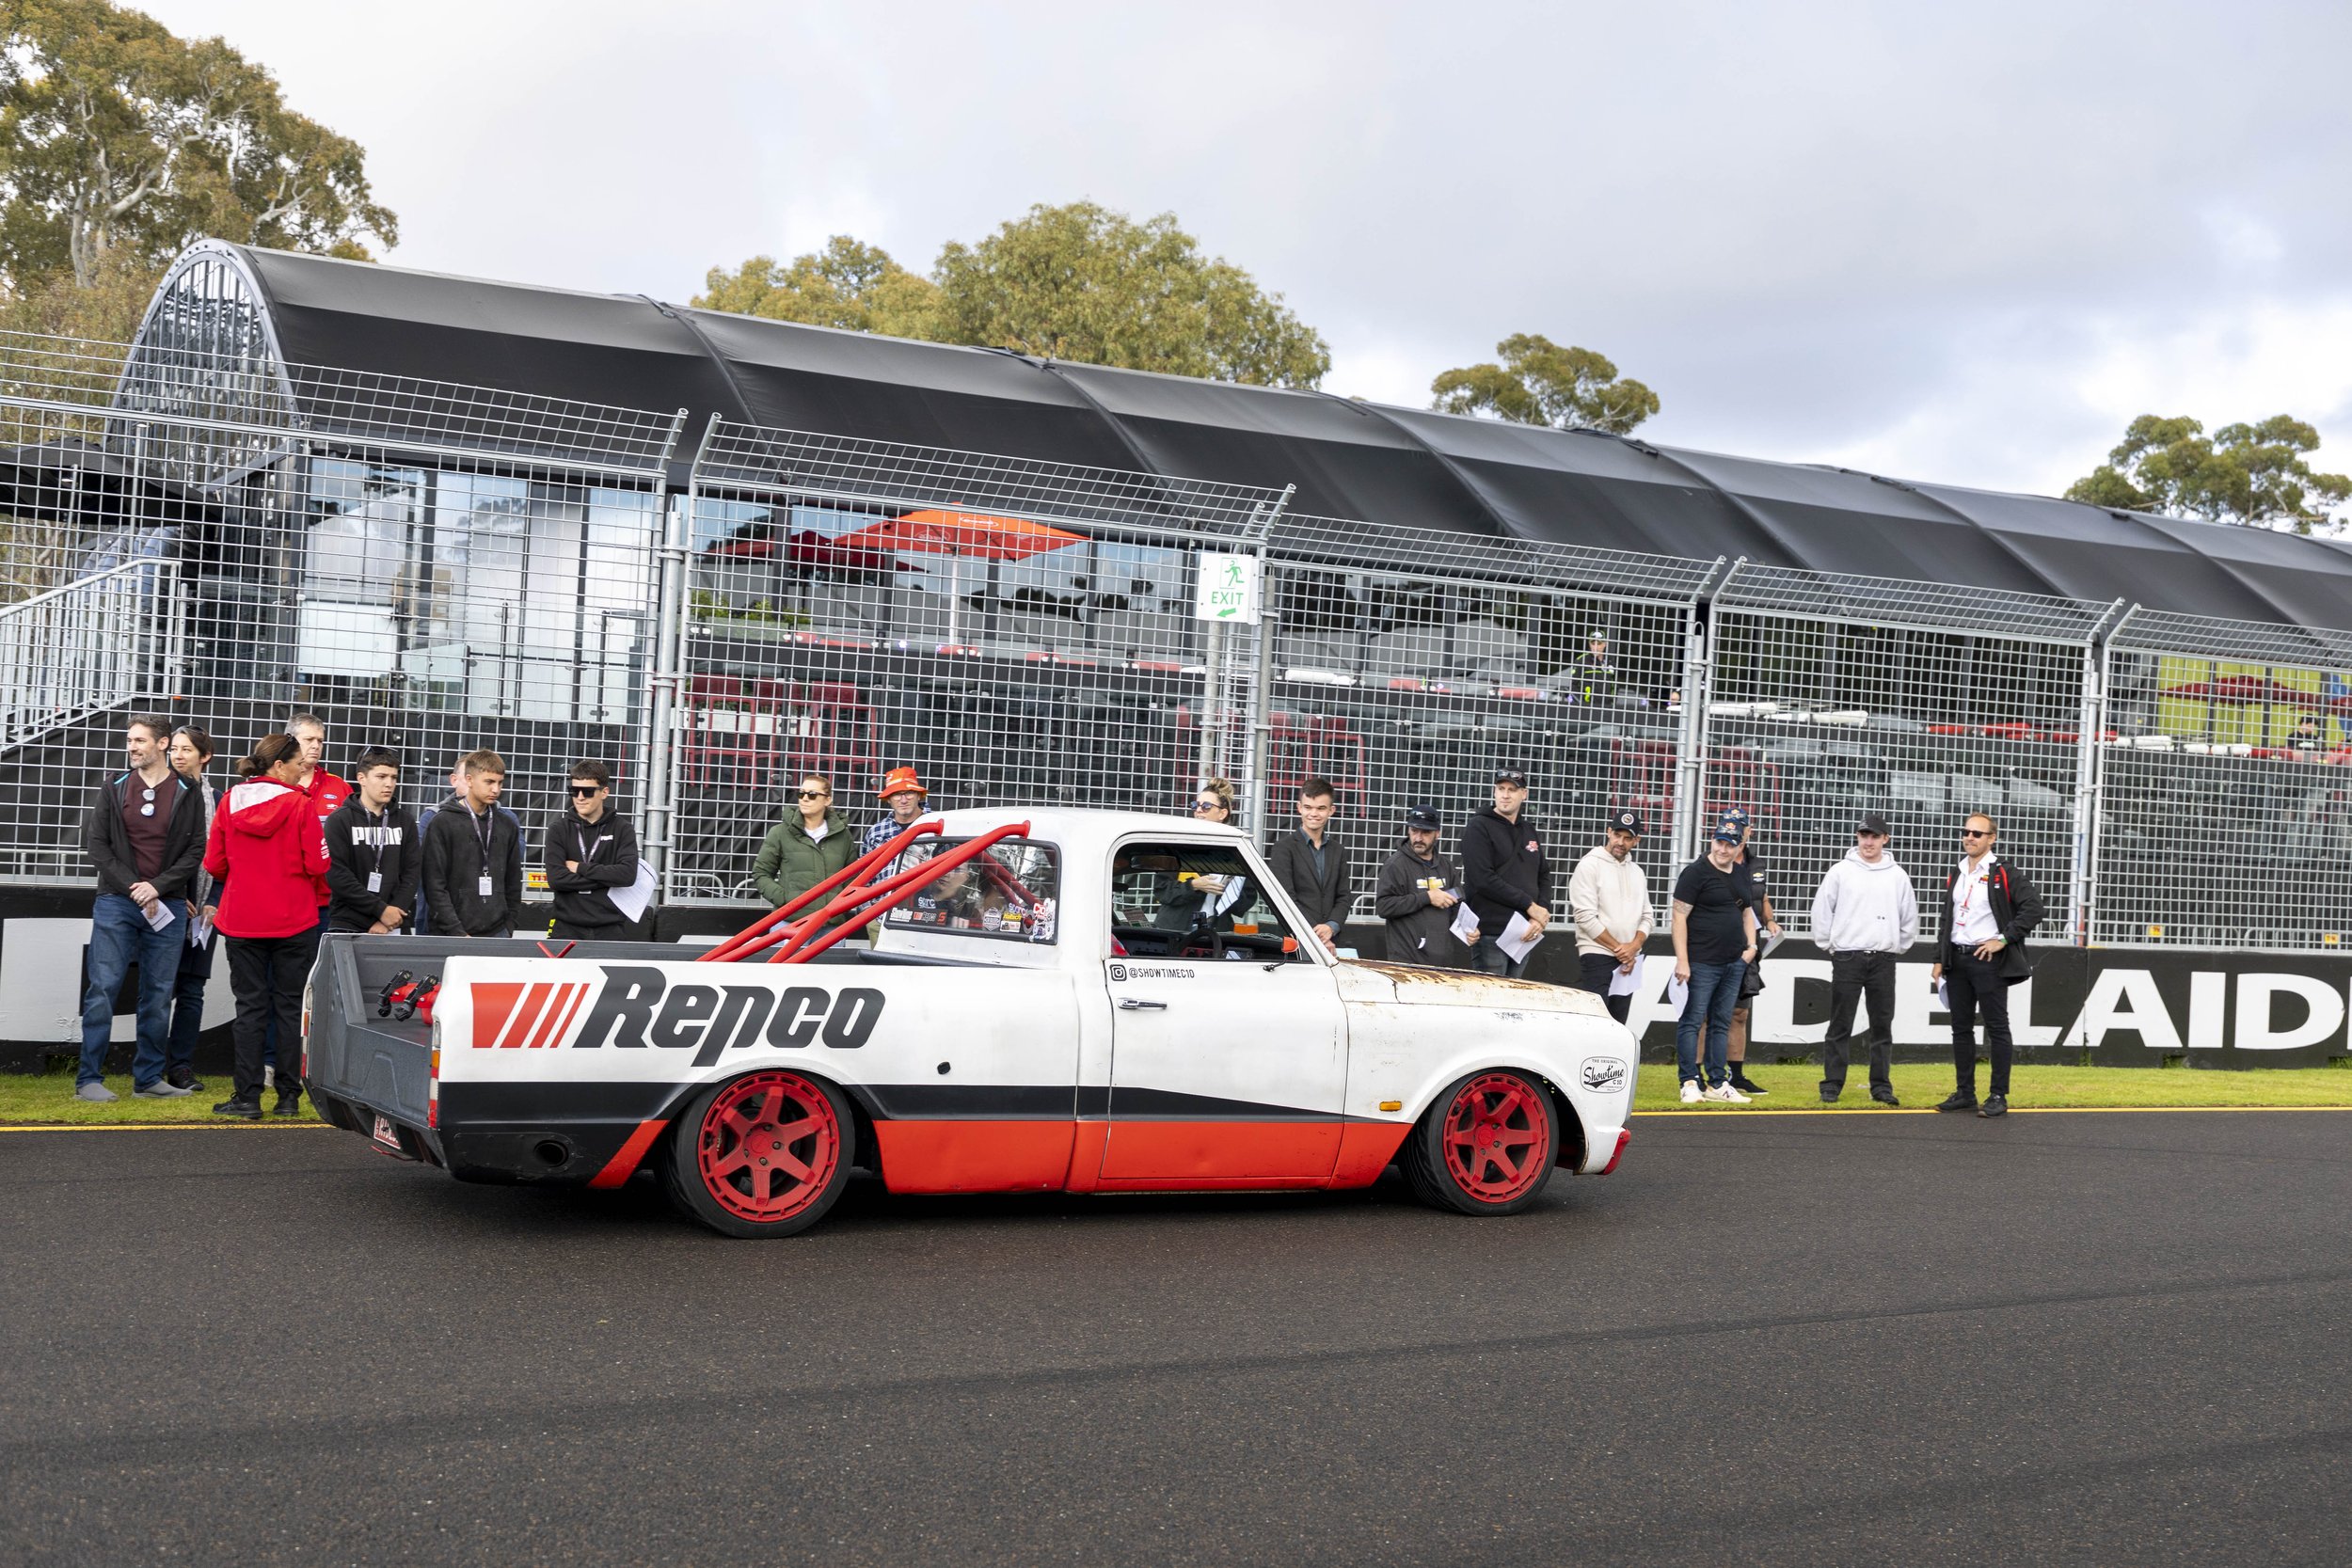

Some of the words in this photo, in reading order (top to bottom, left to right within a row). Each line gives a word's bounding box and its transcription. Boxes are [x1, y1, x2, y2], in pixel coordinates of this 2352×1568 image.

[1212, 592, 1244, 605] EXIT
[352, 827, 403, 845] PUMA
[1128, 967, 1195, 979] @SHOWTIMEC10
[1625, 955, 2352, 1050] ADELAID
[572, 966, 885, 1067] Repco
[1583, 1065, 1624, 1085] Showtime
